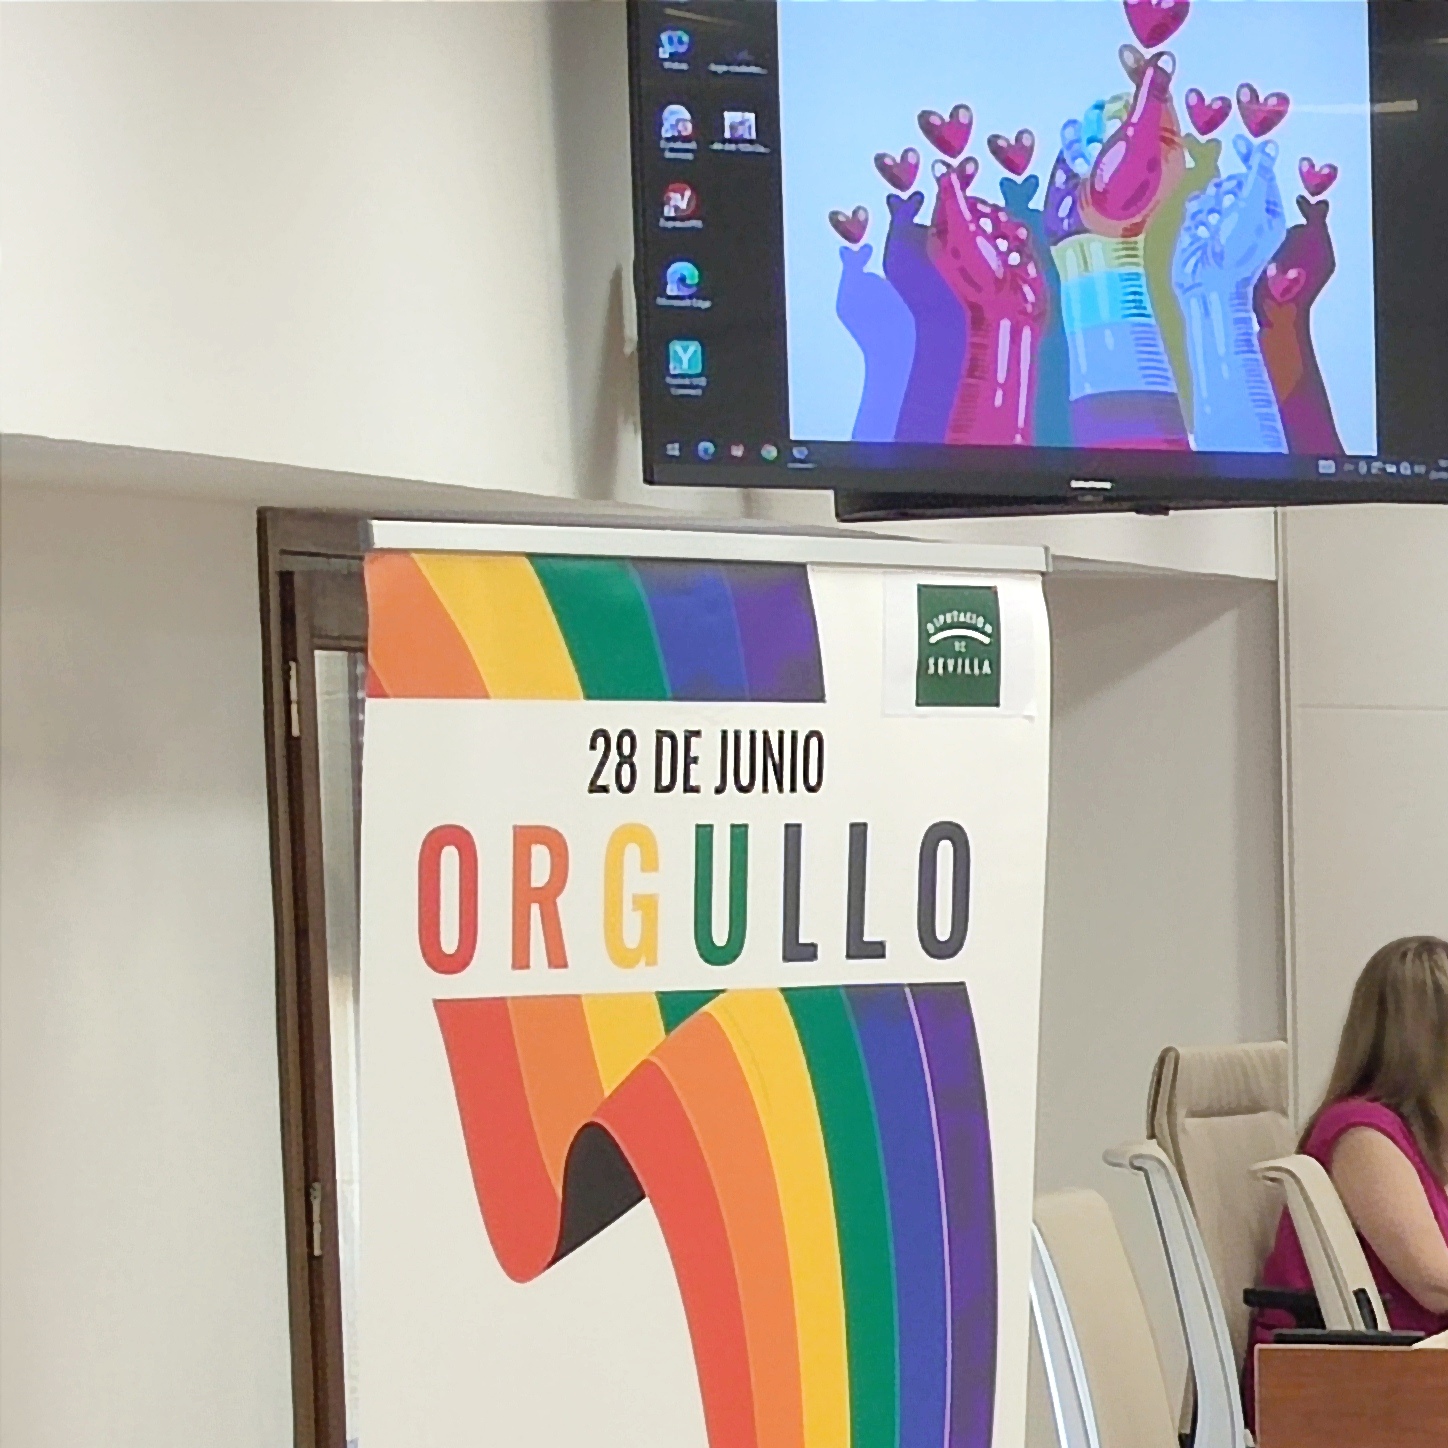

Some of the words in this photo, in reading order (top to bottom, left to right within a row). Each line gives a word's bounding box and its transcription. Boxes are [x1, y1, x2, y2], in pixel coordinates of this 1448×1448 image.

[927, 656, 992, 676] SEVILLA
[586, 728, 639, 795] 28
[653, 728, 701, 795] DE
[713, 728, 826, 796] JUNIO
[416, 820, 972, 976] ORGULLO
